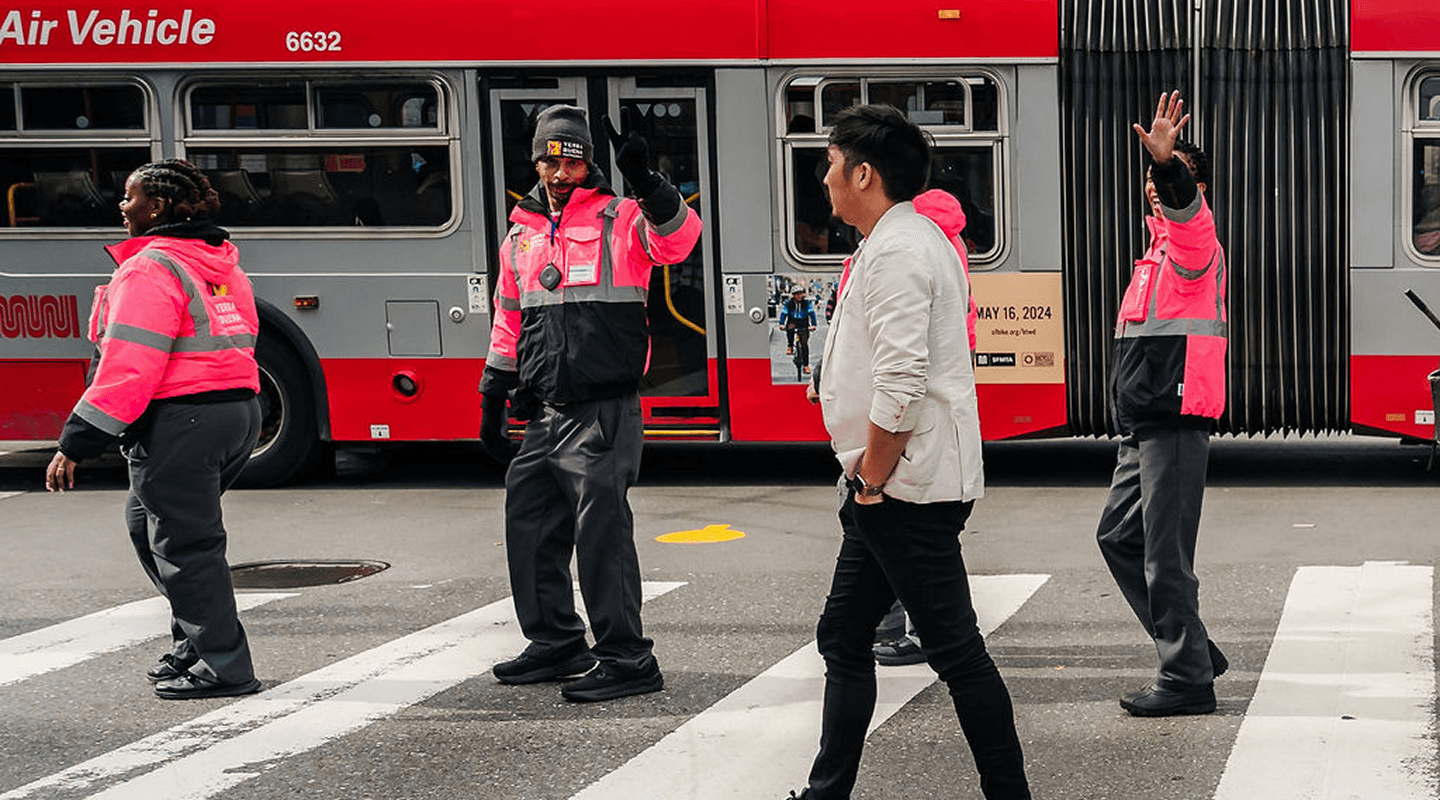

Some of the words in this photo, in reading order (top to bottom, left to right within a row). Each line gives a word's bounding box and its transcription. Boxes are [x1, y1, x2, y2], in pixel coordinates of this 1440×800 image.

[0, 10, 58, 45] Air
[67, 9, 216, 45] Vehicle
[286, 31, 342, 51] 6632
[977, 306, 1000, 320] MAY
[1003, 306, 1019, 321] 16,
[1022, 306, 1052, 320] 2024
